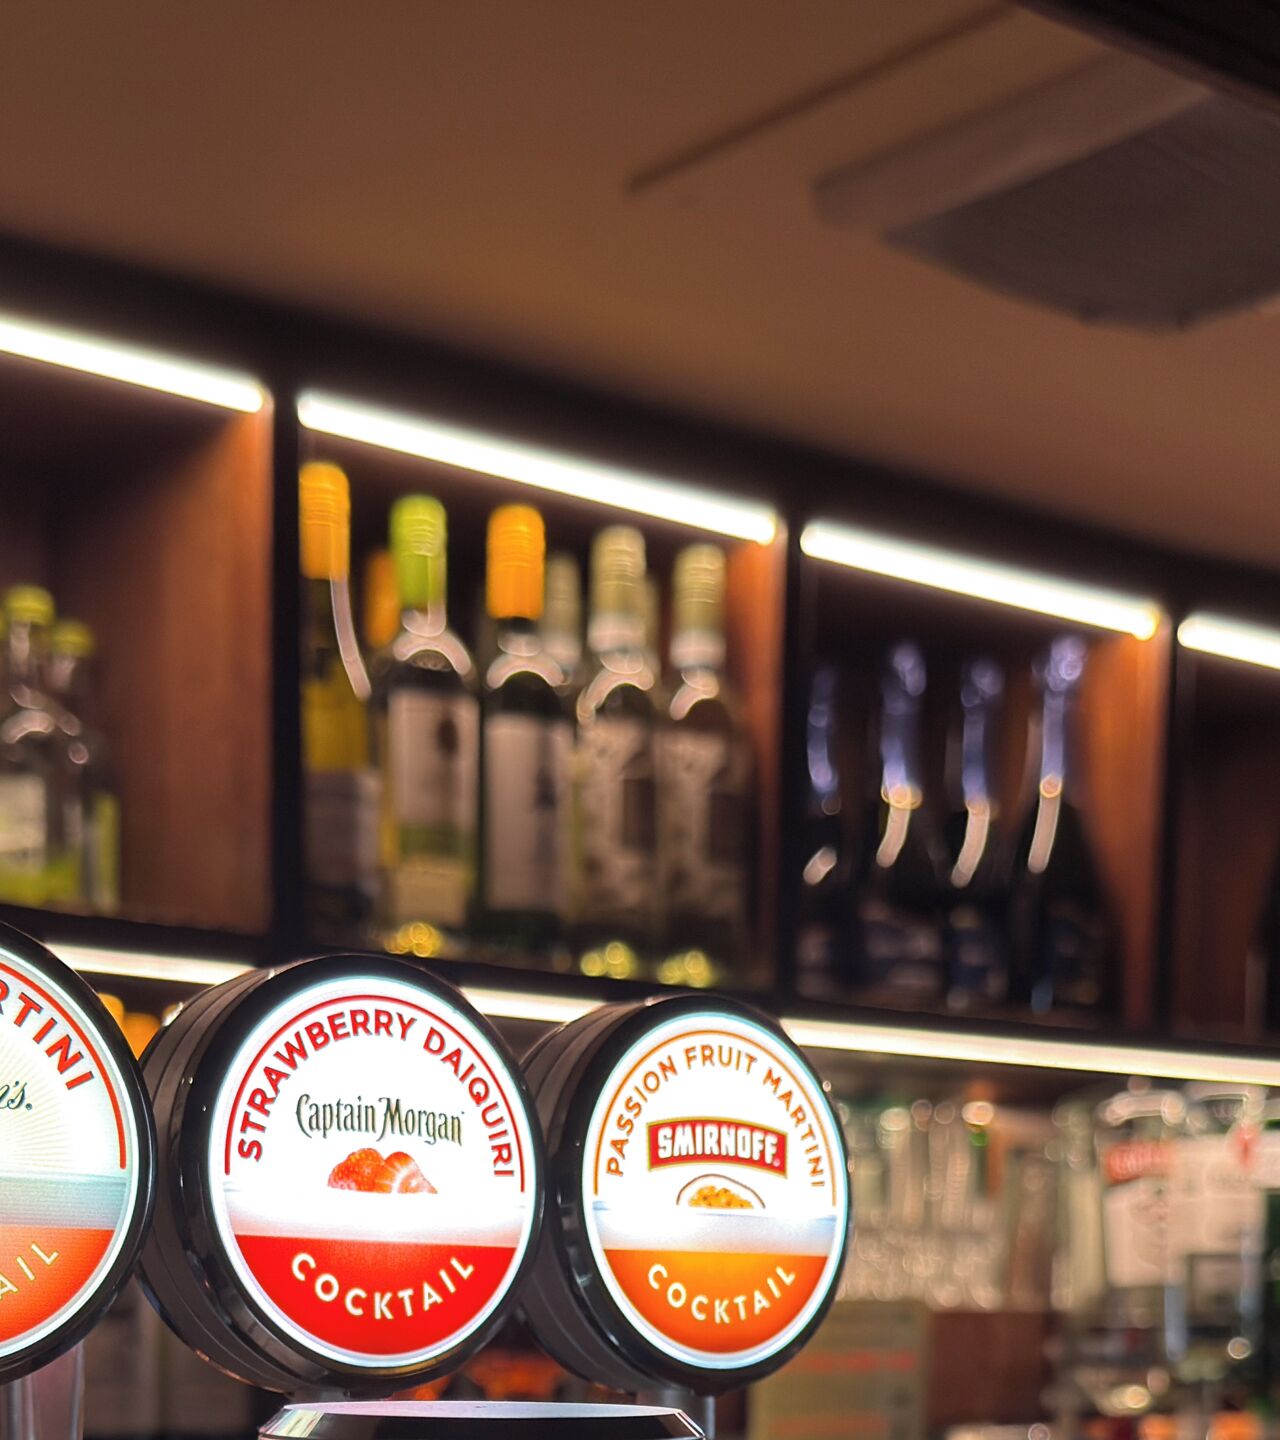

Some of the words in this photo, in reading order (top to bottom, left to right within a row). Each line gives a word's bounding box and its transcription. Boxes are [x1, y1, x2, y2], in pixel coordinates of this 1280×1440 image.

[236, 1008, 417, 1163] STRAWBERRY
[422, 1027, 517, 1178] DAIQUIRI
[293, 1093, 379, 1140] Captain
[376, 1096, 463, 1147] Morgan
[606, 1055, 679, 1177] PASSION
[683, 1044, 758, 1075] FRUIT
[762, 1067, 826, 1188] MARTINI
[656, 1124, 779, 1165] SMIRNOFF
[289, 1251, 476, 1321] COCKTAIL
[647, 1262, 797, 1326] COCKTAIL
